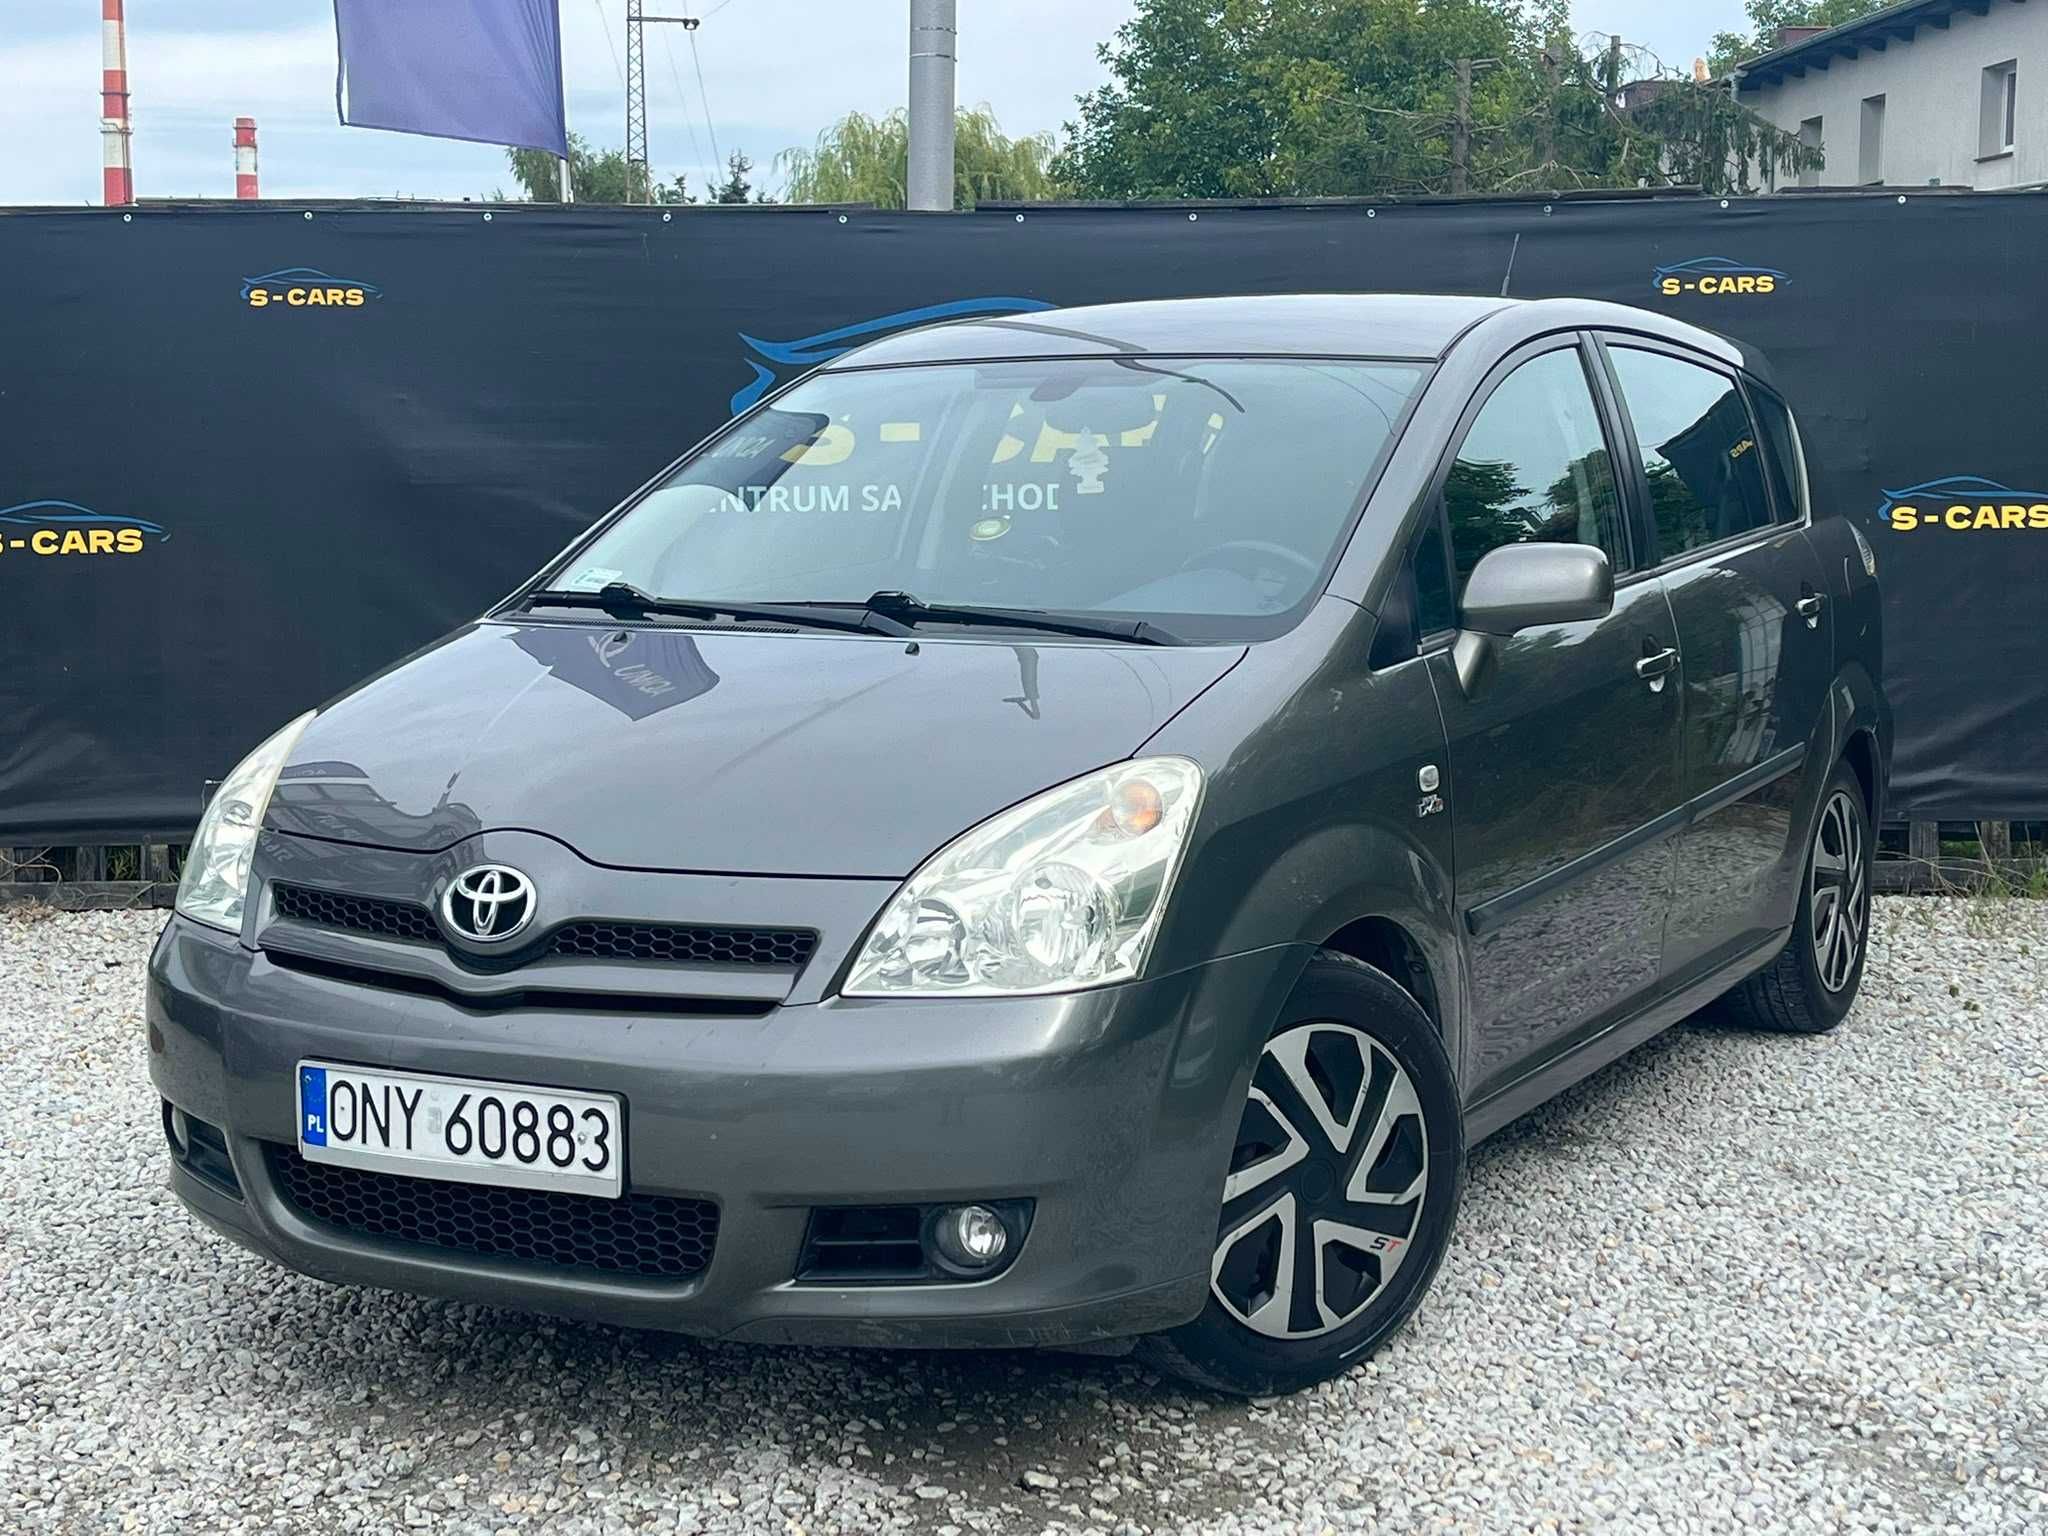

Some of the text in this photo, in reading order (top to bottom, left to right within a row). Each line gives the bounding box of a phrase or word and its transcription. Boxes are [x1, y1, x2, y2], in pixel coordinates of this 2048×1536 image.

[0, 528, 144, 555] -CARS
[306, 1113, 325, 1134] PL
[329, 1079, 610, 1172] ONY 60883
[1369, 1236, 1404, 1254] ST
